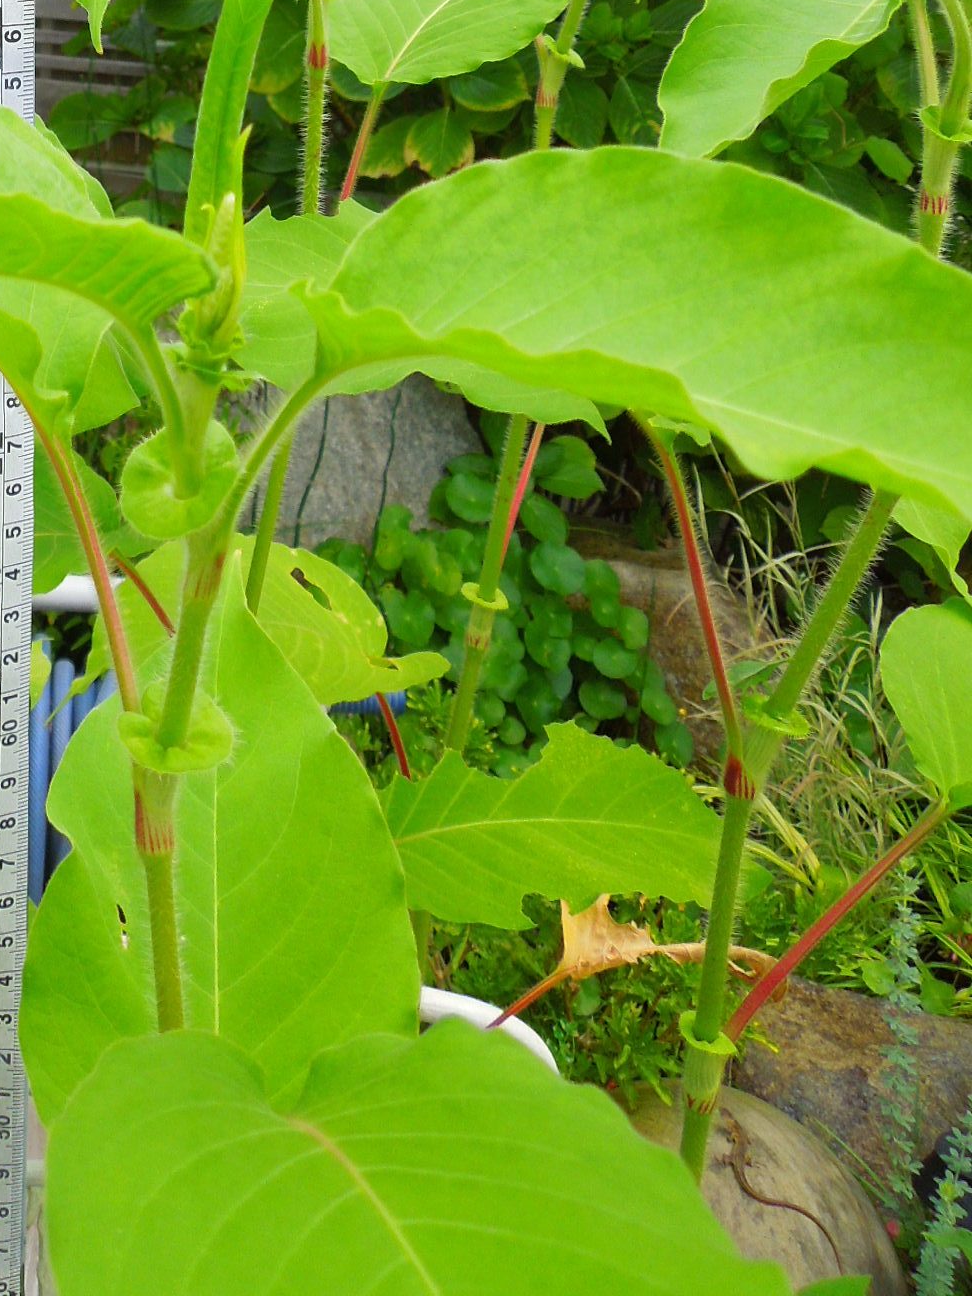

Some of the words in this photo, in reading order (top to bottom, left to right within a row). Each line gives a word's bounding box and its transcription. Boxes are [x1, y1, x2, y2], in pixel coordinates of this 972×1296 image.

[5, 30, 21, 43] 6
[5, 77, 21, 90] 5
[7, 396, 21, 408] 8
[7, 441, 22, 453] 7
[6, 483, 21, 496] 6
[6, 526, 21, 538] 5
[5, 568, 20, 580] 4
[4, 610, 19, 623] 3
[3, 652, 19, 666] 2
[3, 695, 18, 703] 1
[2, 719, 18, 746] 60
[0, 777, 16, 789] 9
[0, 817, 16, 829] 8
[0, 859, 15, 870] 7
